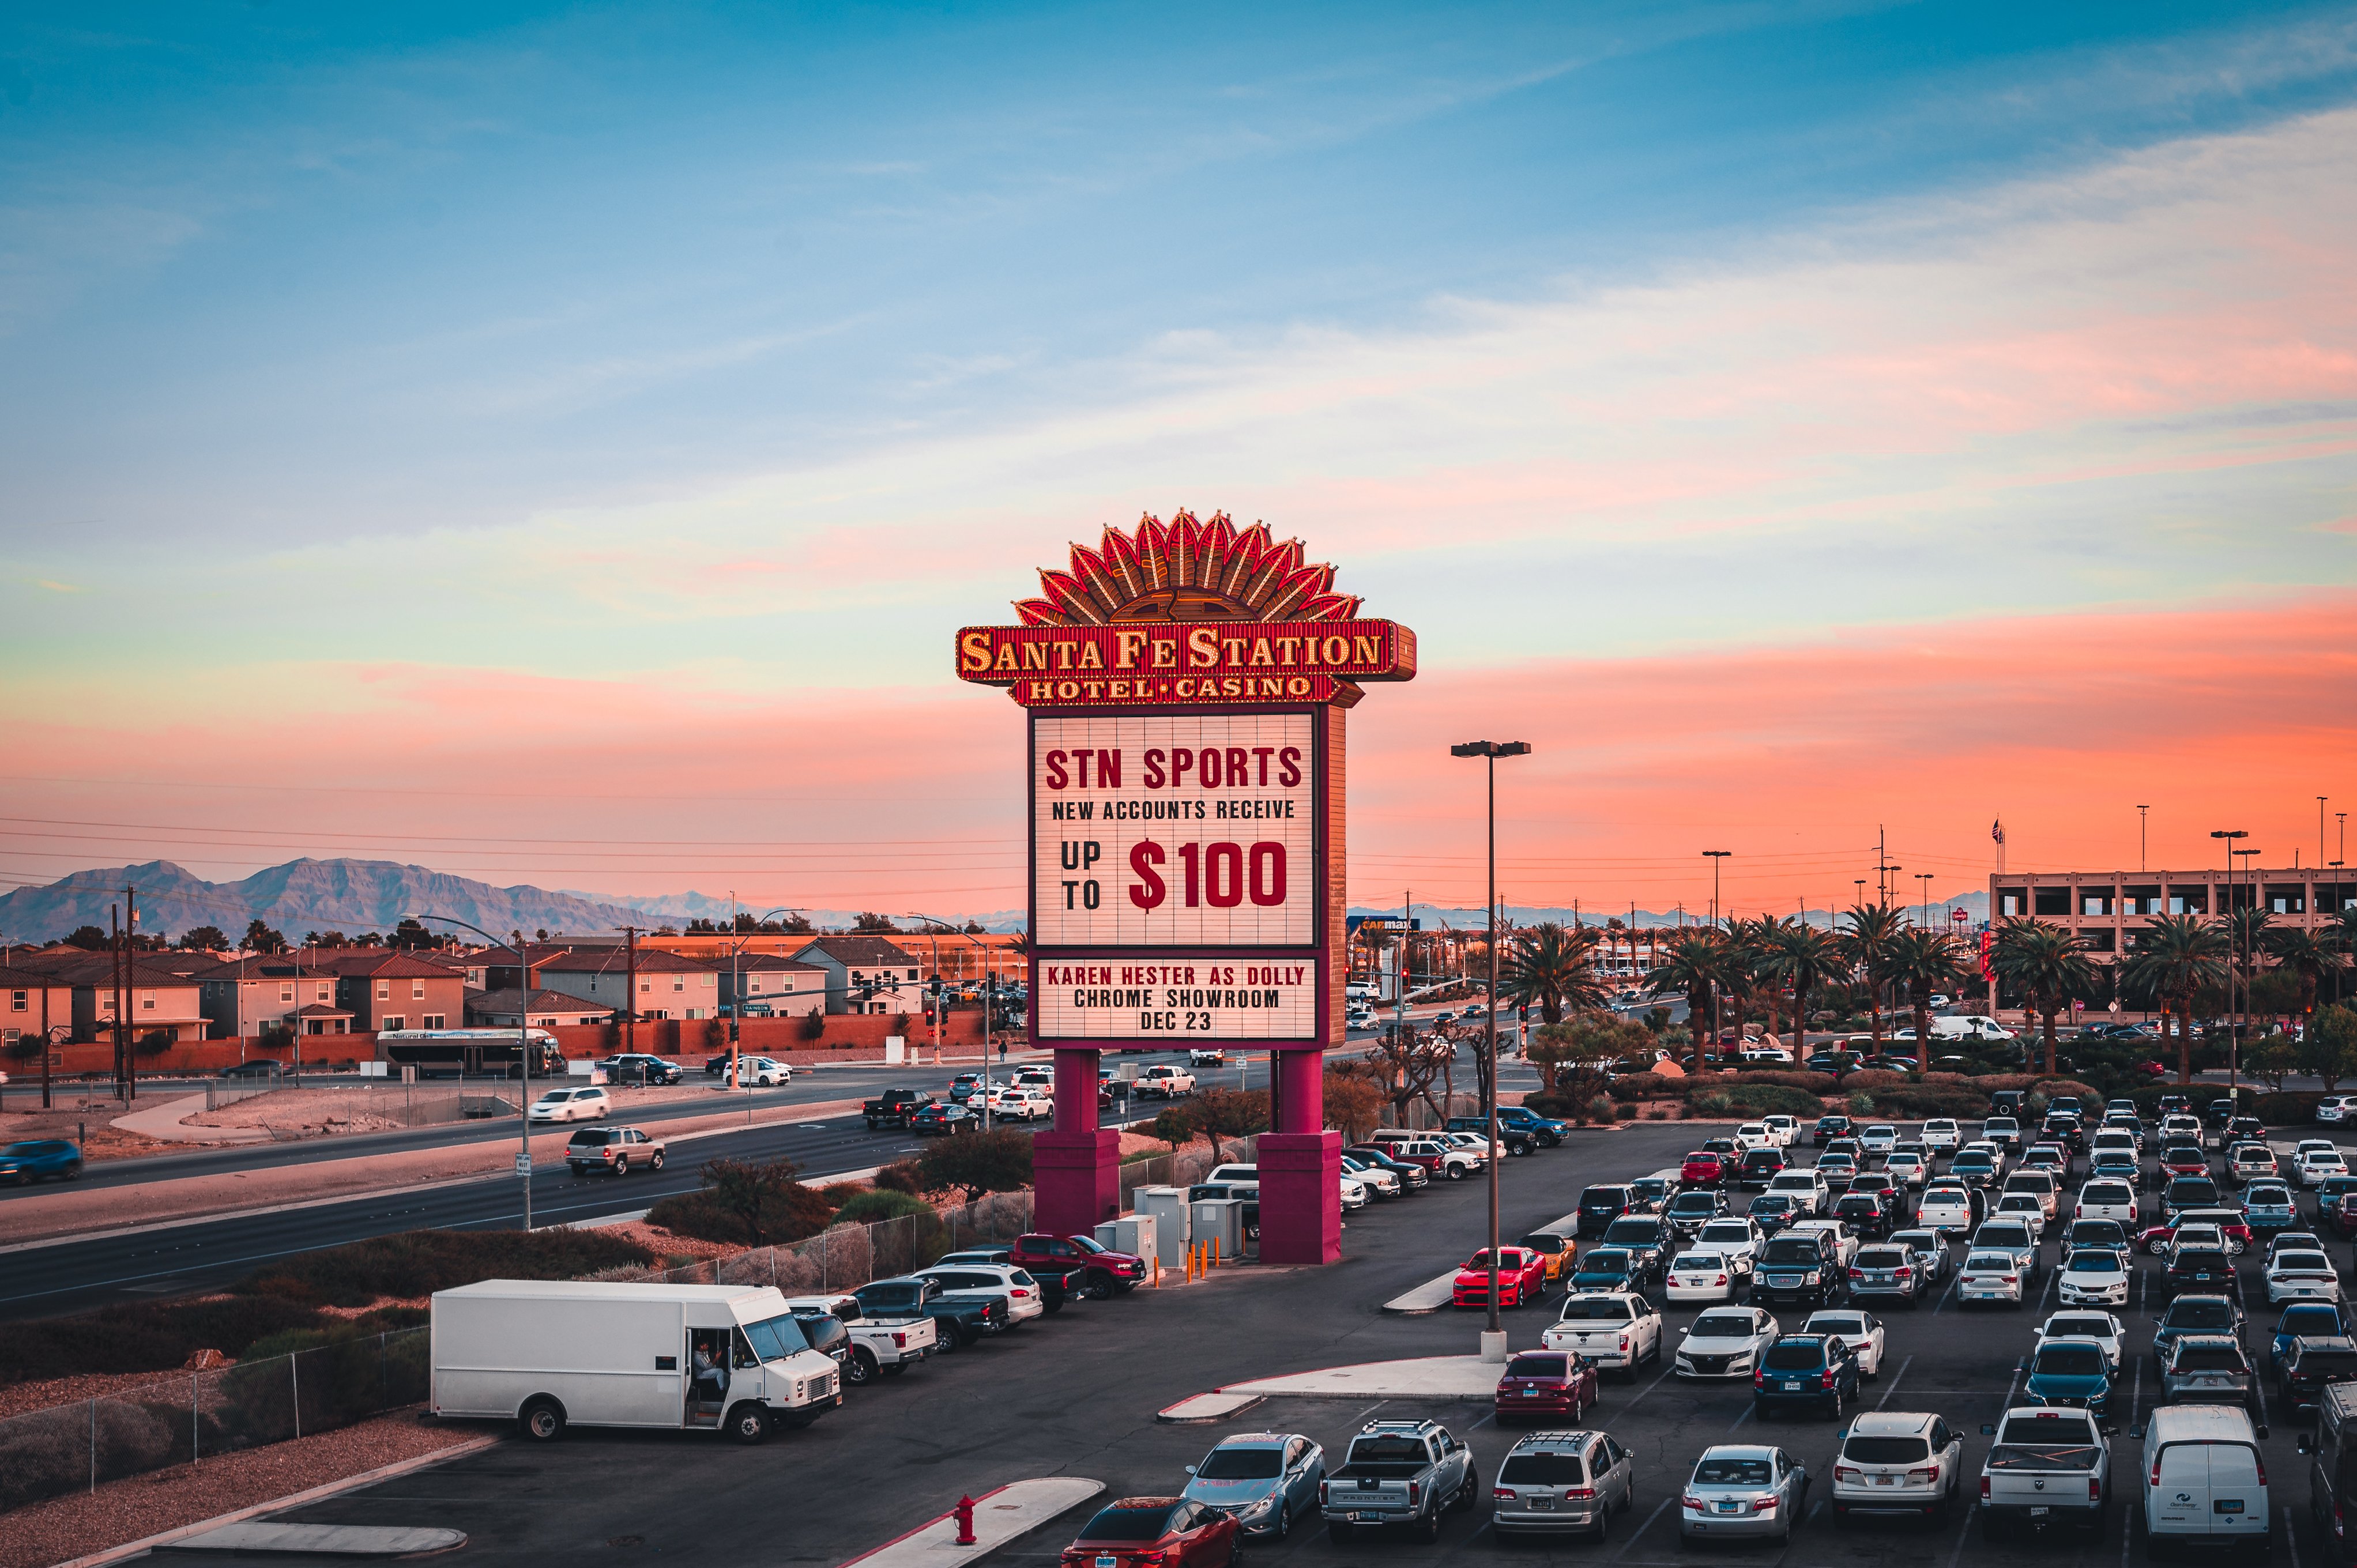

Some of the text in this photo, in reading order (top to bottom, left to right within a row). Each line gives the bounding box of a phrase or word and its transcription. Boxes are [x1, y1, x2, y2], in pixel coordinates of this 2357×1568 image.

[962, 627, 1381, 672] SANTA FE STATION
[1029, 677, 1311, 700] HOTEL CASINO
[1046, 747, 1301, 790] STN SPORTS
[1053, 800, 1294, 820] NEW ACCOUNTS RECEIVE
[1061, 840, 1101, 870] UP
[1129, 838, 1287, 915] $100
[1062, 880, 1100, 910] TO
[1049, 967, 1304, 985] KAREN HESTER AS DOLLY
[1074, 989, 1279, 1008] CHROME SHOWROOM
[1141, 1011, 1211, 1031] DEC 23
